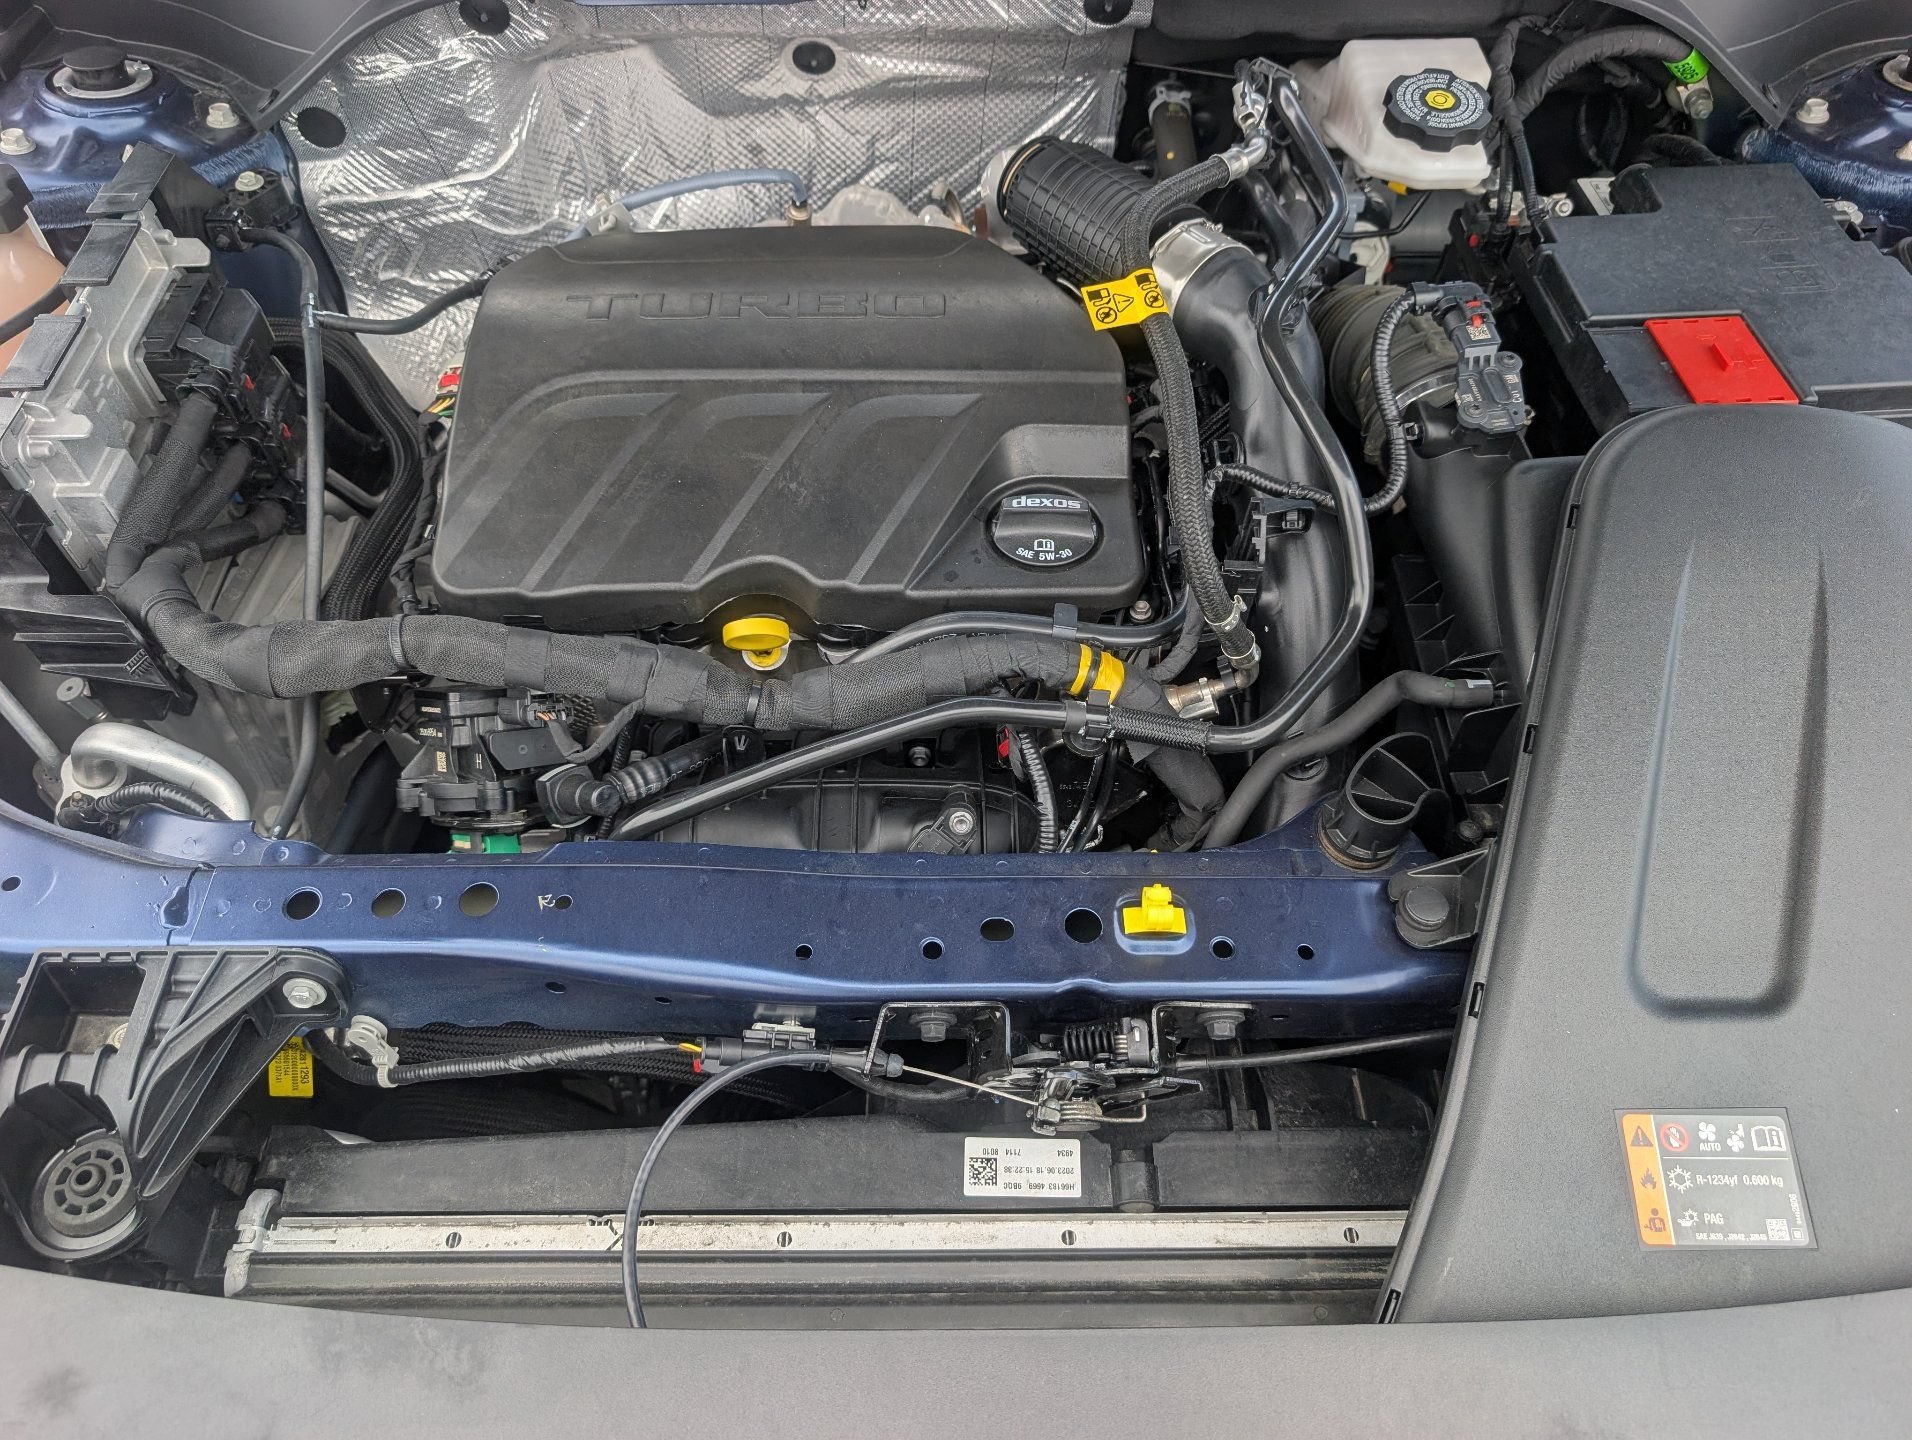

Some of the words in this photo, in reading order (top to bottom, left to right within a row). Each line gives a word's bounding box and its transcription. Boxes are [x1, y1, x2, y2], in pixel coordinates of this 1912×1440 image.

[567, 292, 946, 321] TURBO
[1012, 496, 1081, 509] dexos
[1016, 547, 1035, 559] SAE
[1039, 548, 1073, 560] 5W-30
[300, 1066, 309, 1084] 1293
[983, 1148, 999, 1156] 8010
[1005, 1148, 1021, 1156] 7114
[1699, 1142, 1721, 1151] AUTO
[1036, 1166, 1075, 1174] 2023.06.18
[1696, 1174, 1738, 1187] R-1234yf
[1743, 1175, 1769, 1186] 0.600
[1770, 1175, 1784, 1188] kg
[1703, 1212, 1724, 1225] PAG
